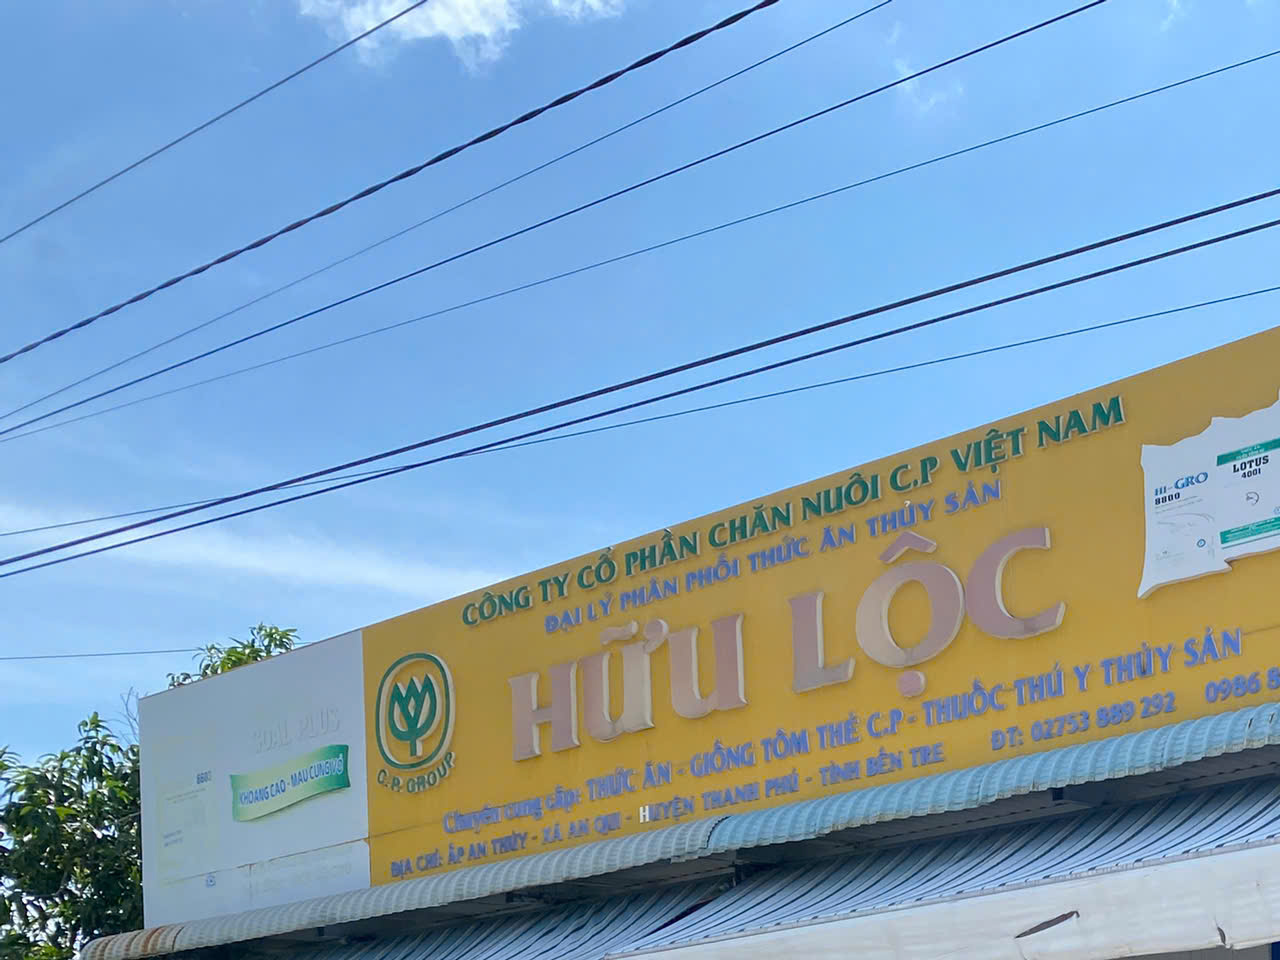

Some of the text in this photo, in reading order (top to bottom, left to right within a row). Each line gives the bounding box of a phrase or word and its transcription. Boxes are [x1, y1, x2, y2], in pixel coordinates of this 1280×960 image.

[1233, 455, 1269, 473] LOTUS
[462, 395, 1125, 626] CÔNG TY CỔ PHẦN CHĂN NUÔI C.P VIỆT NAM
[544, 607, 582, 633] ĐẠI
[620, 576, 679, 611] PHÂN
[686, 552, 740, 592] PHỐI
[747, 534, 810, 574] THỨC
[820, 523, 857, 552] ĂN
[866, 500, 935, 537] THỦY
[944, 478, 1001, 514] SẢN
[508, 527, 1066, 762] HỮU LỘC
[1205, 671, 1261, 703] 0986
[503, 796, 543, 821] cung
[586, 765, 638, 801] THỨC
[642, 761, 672, 790] ĂN
[690, 738, 756, 778] GIỐNG
[761, 727, 809, 762] TÔM
[867, 708, 904, 738] C.P
[922, 678, 1007, 727] THUỐC
[1014, 662, 1065, 706] THÚ
[1073, 663, 1092, 692] Y
[1101, 642, 1173, 686] THỦY
[1183, 625, 1243, 668] SẢN
[991, 691, 1177, 751] ĐT: 02753 889 292
[270, 779, 287, 797] CAO
[407, 751, 456, 793] GROUP
[467, 841, 487, 860] AN
[866, 746, 904, 777] BẾN
[909, 741, 946, 769] TRE
